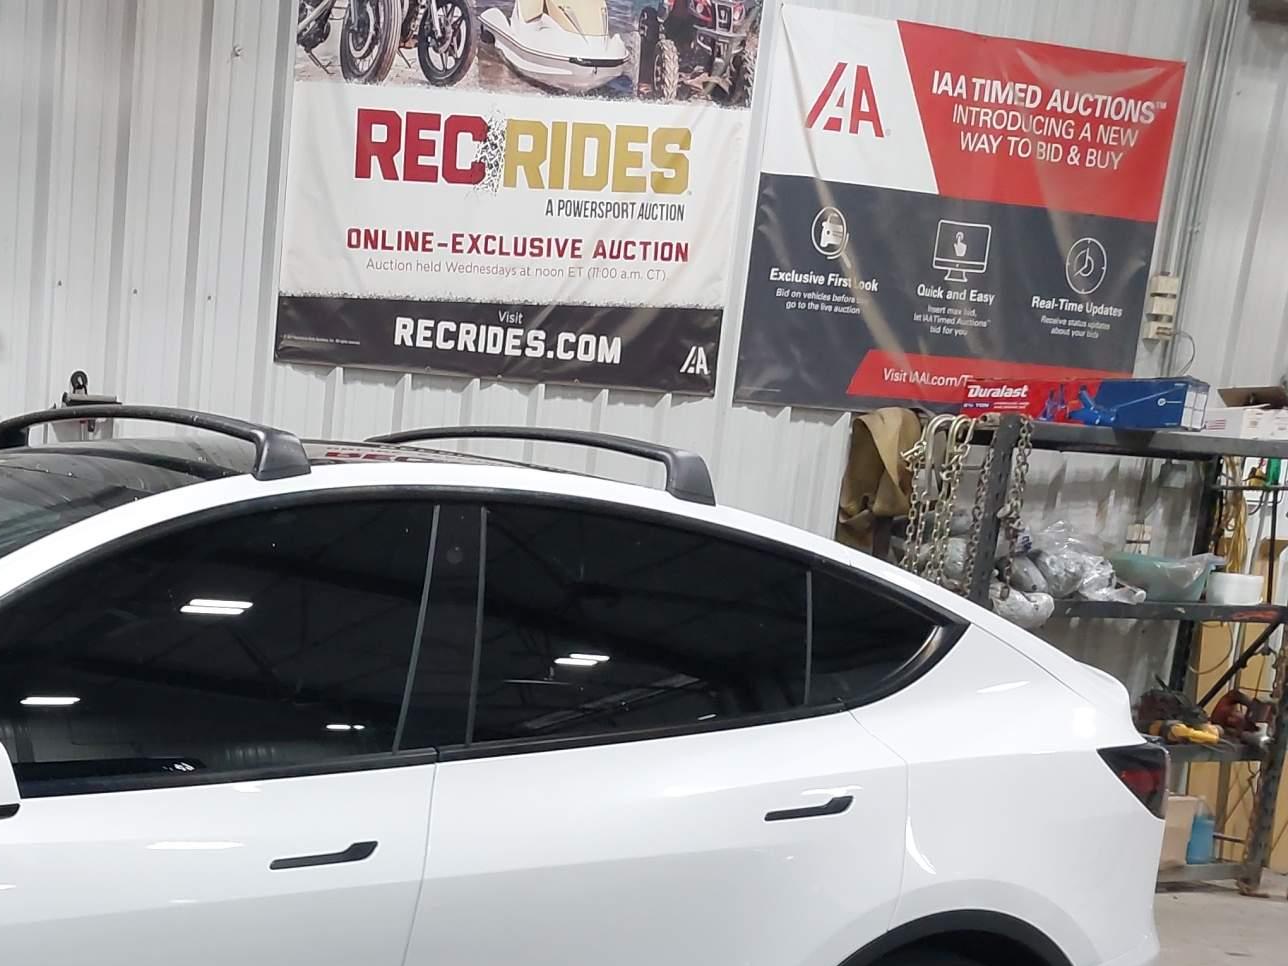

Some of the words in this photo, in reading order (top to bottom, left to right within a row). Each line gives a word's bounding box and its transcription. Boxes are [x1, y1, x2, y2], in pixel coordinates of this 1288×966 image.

[932, 70, 967, 99] IAA
[971, 78, 1042, 109] TIMED
[953, 104, 1075, 140] INTRODUCING
[1078, 122, 1092, 142] A
[1096, 124, 1139, 147] NEW
[354, 108, 488, 186] REC
[503, 118, 692, 195] RIDES
[961, 131, 1004, 156] WAY
[1006, 136, 1032, 158] TO
[1036, 141, 1063, 163] BID
[1067, 145, 1081, 166] &
[1085, 149, 1124, 170] BUY
[545, 199, 554, 217] A
[557, 200, 637, 219] POWERSPORT
[637, 203, 685, 222] AUCTION
[346, 228, 584, 259] ONLINE-EXCLUSIVE
[592, 239, 690, 262] AUCTION
[366, 258, 413, 273] Auction
[416, 260, 442, 273] held
[446, 261, 517, 277] Wednesdays
[519, 265, 531, 277] at
[535, 267, 564, 278] noon
[568, 267, 585, 278] ET
[769, 267, 825, 285] Exclusive
[827, 273, 852, 288] First
[776, 287, 790, 298] Bid
[791, 290, 802, 299] on
[803, 290, 832, 302] vehicles
[832, 293, 856, 304] before
[917, 283, 945, 299] Quick
[946, 289, 967, 301] and
[969, 289, 995, 306] Easy
[786, 300, 796, 310] go
[798, 300, 807, 310] to
[808, 301, 820, 311] the
[821, 302, 833, 313] live
[834, 304, 861, 315] auction
[1031, 295, 1084, 313] Real-Time
[1086, 302, 1123, 317] Updates
[497, 310, 524, 325] Visit
[393, 316, 622, 364] RECRIDES.COM
[883, 367, 907, 383] Visit
[967, 384, 1029, 398] Duralast
